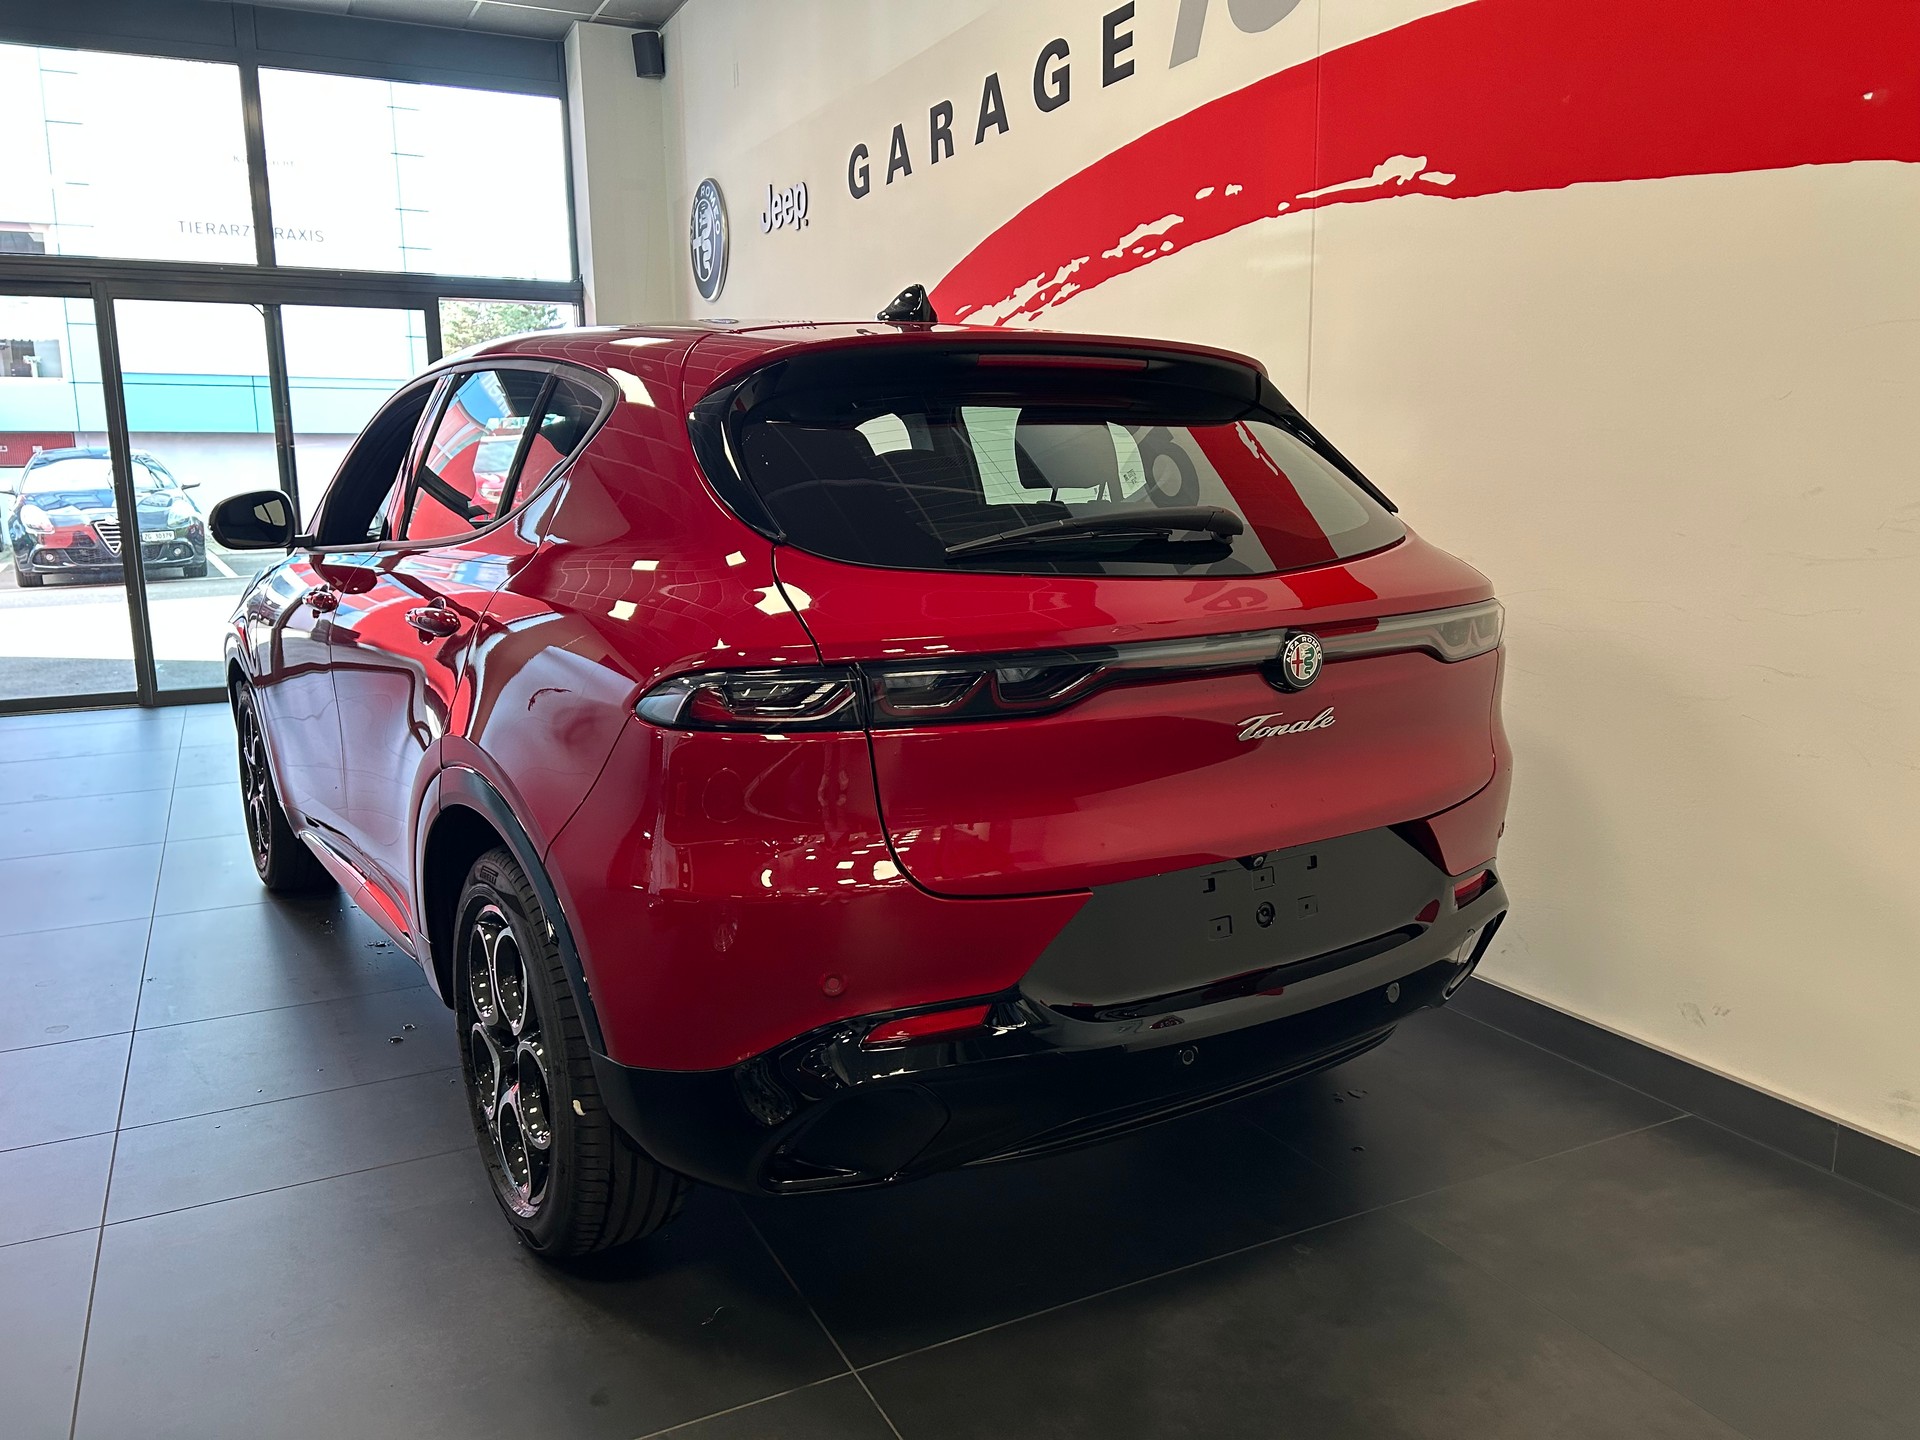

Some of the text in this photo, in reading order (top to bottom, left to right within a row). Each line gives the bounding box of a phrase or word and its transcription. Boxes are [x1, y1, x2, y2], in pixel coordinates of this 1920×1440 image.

[848, 1, 1135, 199] GARAGE
[700, 185, 721, 235] ROMEO
[761, 182, 808, 234] Jeep
[178, 220, 325, 243] TIERARZRAXIS
[1286, 636, 1322, 663] ALFA ROMEO
[1237, 706, 1336, 742] Tonale
